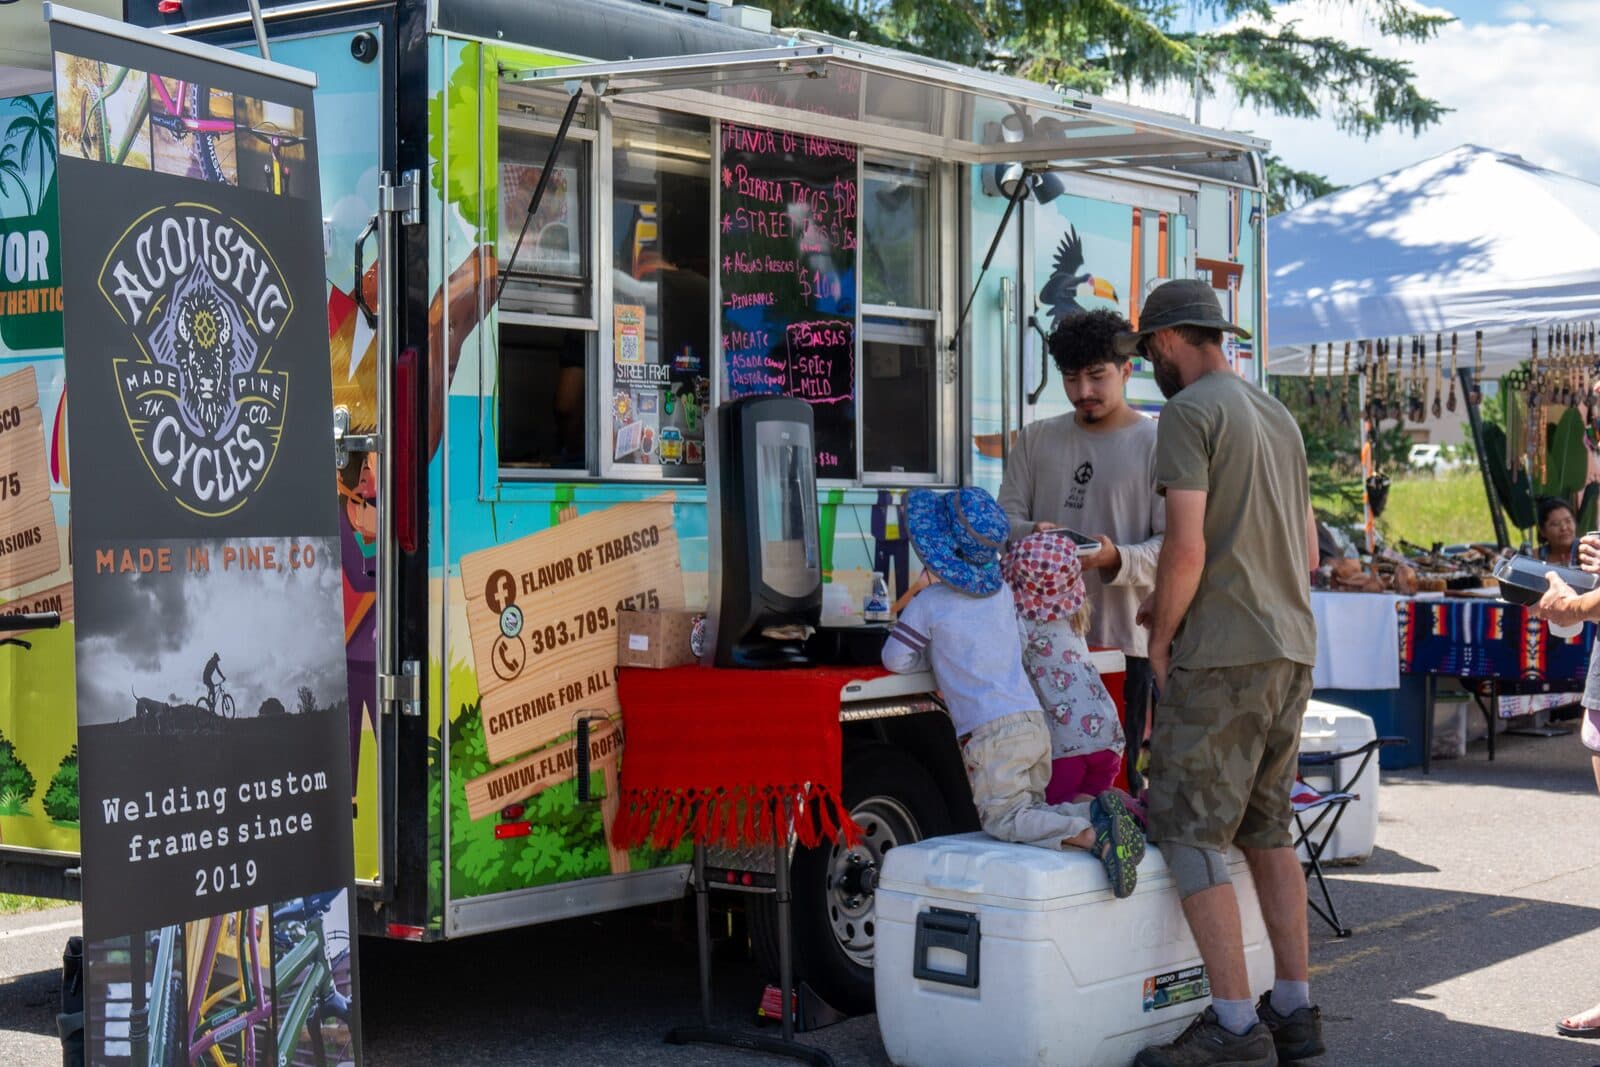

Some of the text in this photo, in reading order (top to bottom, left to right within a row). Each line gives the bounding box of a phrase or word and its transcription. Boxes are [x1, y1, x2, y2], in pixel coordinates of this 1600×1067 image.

[206, 133, 225, 182] WHISKY
[782, 130, 797, 153] OF
[735, 164, 784, 204] BIRRIA
[790, 181, 829, 214] TACOS
[112, 216, 289, 334] ACOUSTIC
[126, 370, 281, 400] MADE PINE
[616, 363, 671, 380] STREET FRAT
[152, 416, 265, 502] CYCLES
[0, 471, 21, 501] 75
[0, 526, 41, 557] ASIONS
[95, 548, 173, 574] MADE
[186, 548, 210, 572] IN
[521, 524, 660, 595] FLAVOR OF TABASCO
[489, 692, 556, 735] CATERING
[558, 681, 583, 706] FOR
[588, 668, 611, 695] ALL
[103, 770, 328, 824] Welding custom
[128, 812, 313, 862] frames since
[195, 860, 258, 896] 2019
